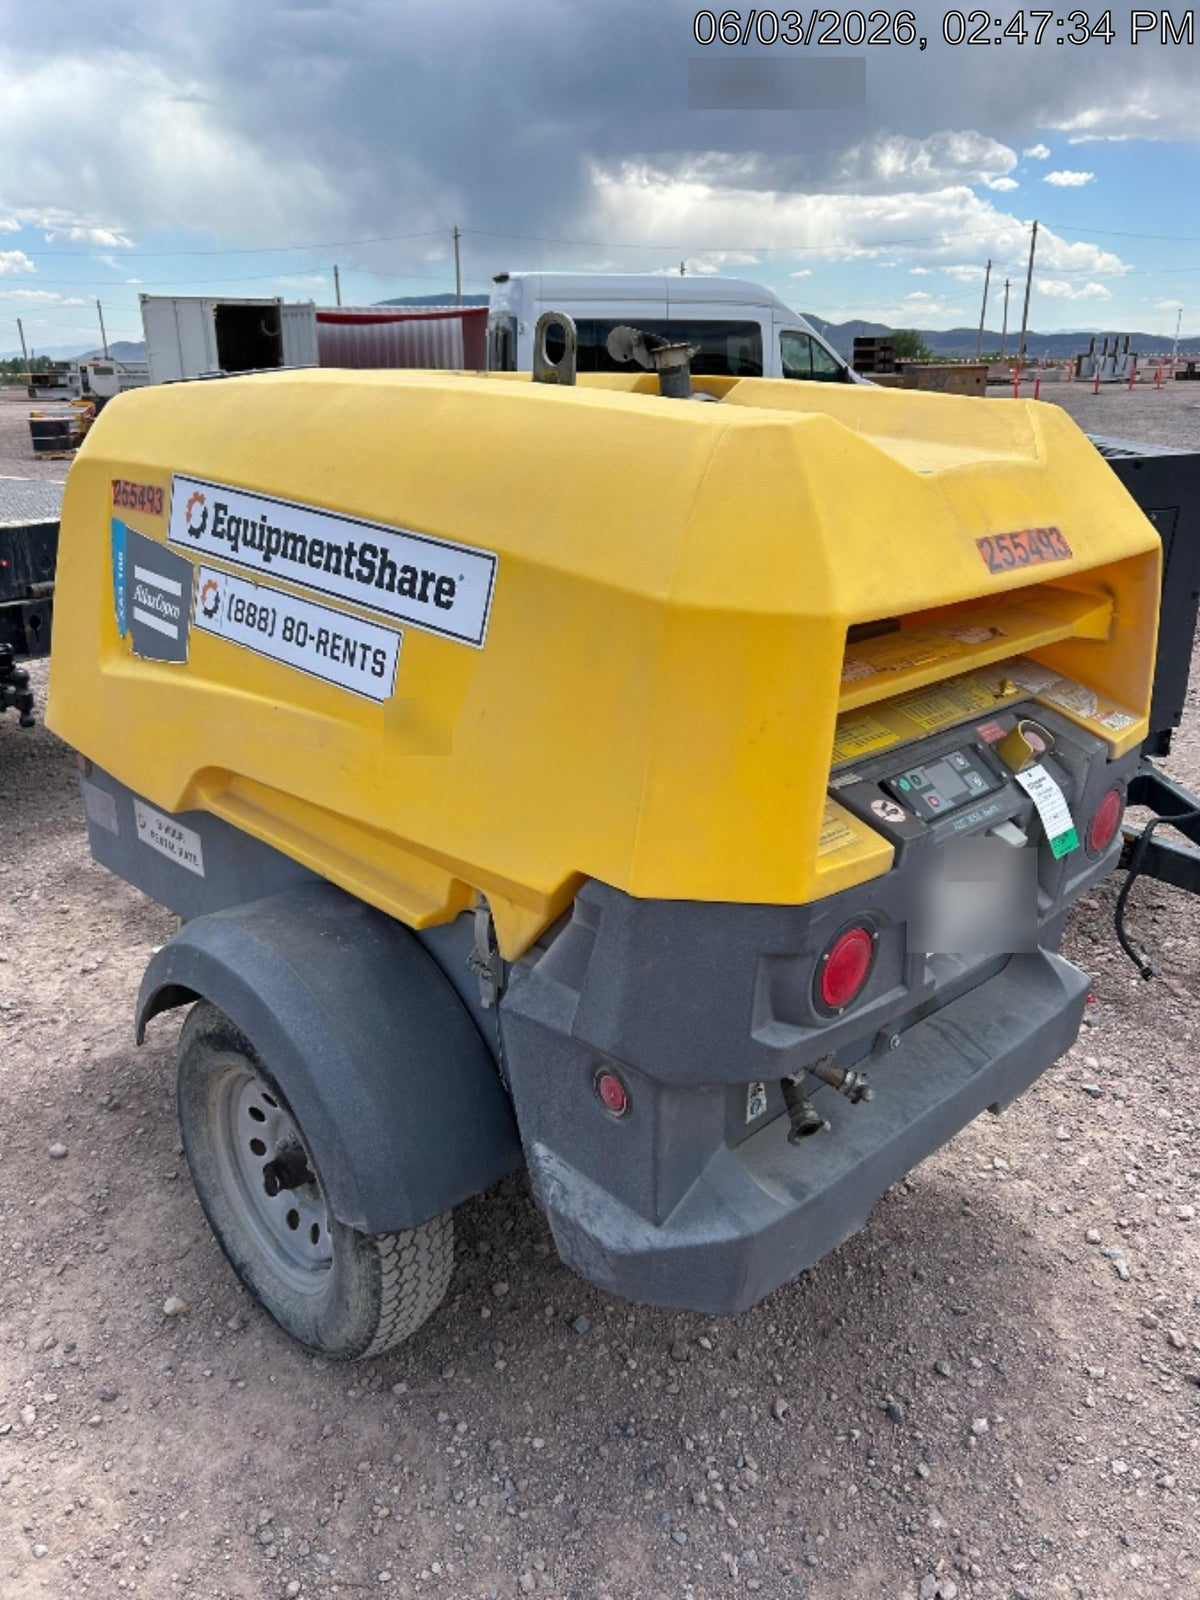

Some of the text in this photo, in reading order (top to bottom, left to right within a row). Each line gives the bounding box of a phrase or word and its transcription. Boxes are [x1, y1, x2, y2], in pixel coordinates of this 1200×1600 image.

[112, 479, 163, 515] 255493
[210, 502, 457, 611] EquipmentShare
[978, 526, 1069, 571] 255493
[226, 592, 387, 678] (888) 80-RENTS
